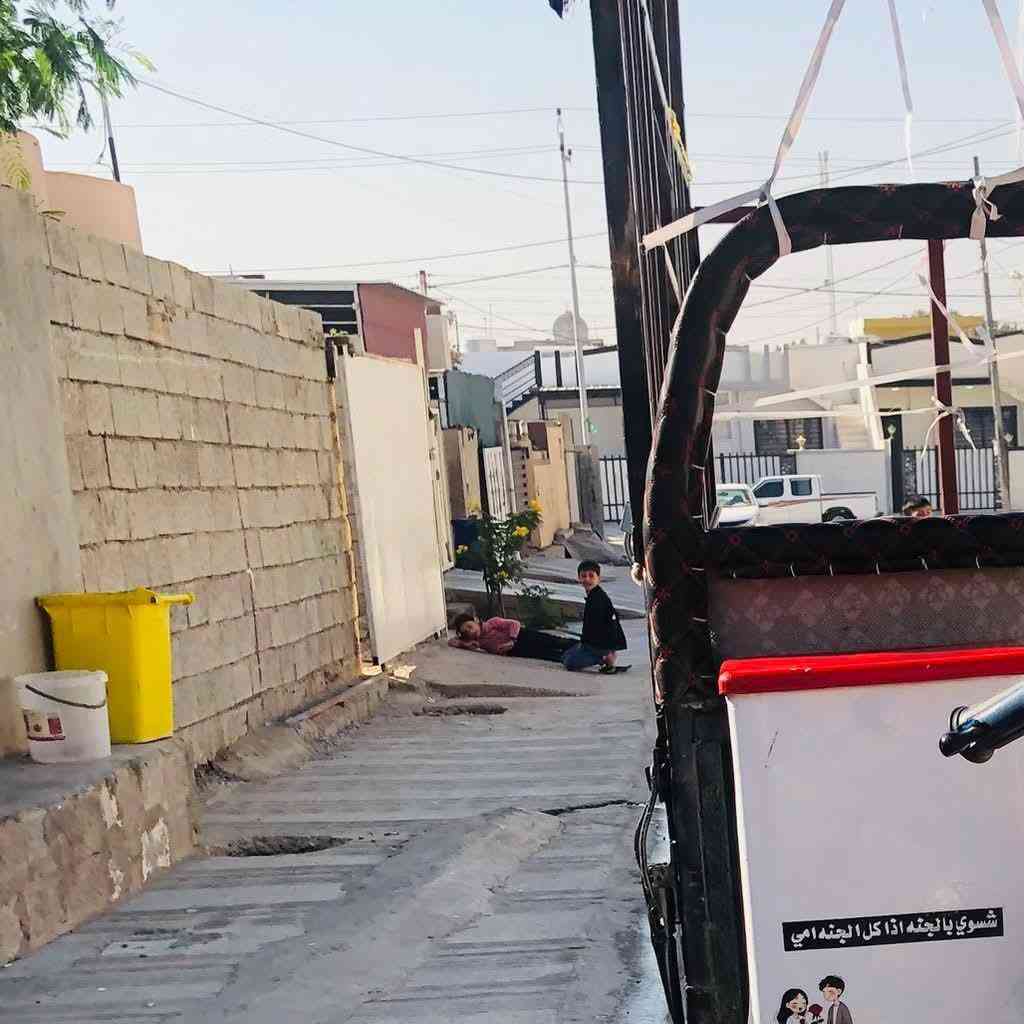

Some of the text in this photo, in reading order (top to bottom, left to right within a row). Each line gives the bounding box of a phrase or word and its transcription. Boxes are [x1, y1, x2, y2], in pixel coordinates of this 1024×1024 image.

[818, 923, 861, 945] الجنه
[862, 920, 882, 941] كل
[885, 918, 904, 936] اذا
[955, 910, 998, 936] شسوي
[790, 926, 817, 948] امي
